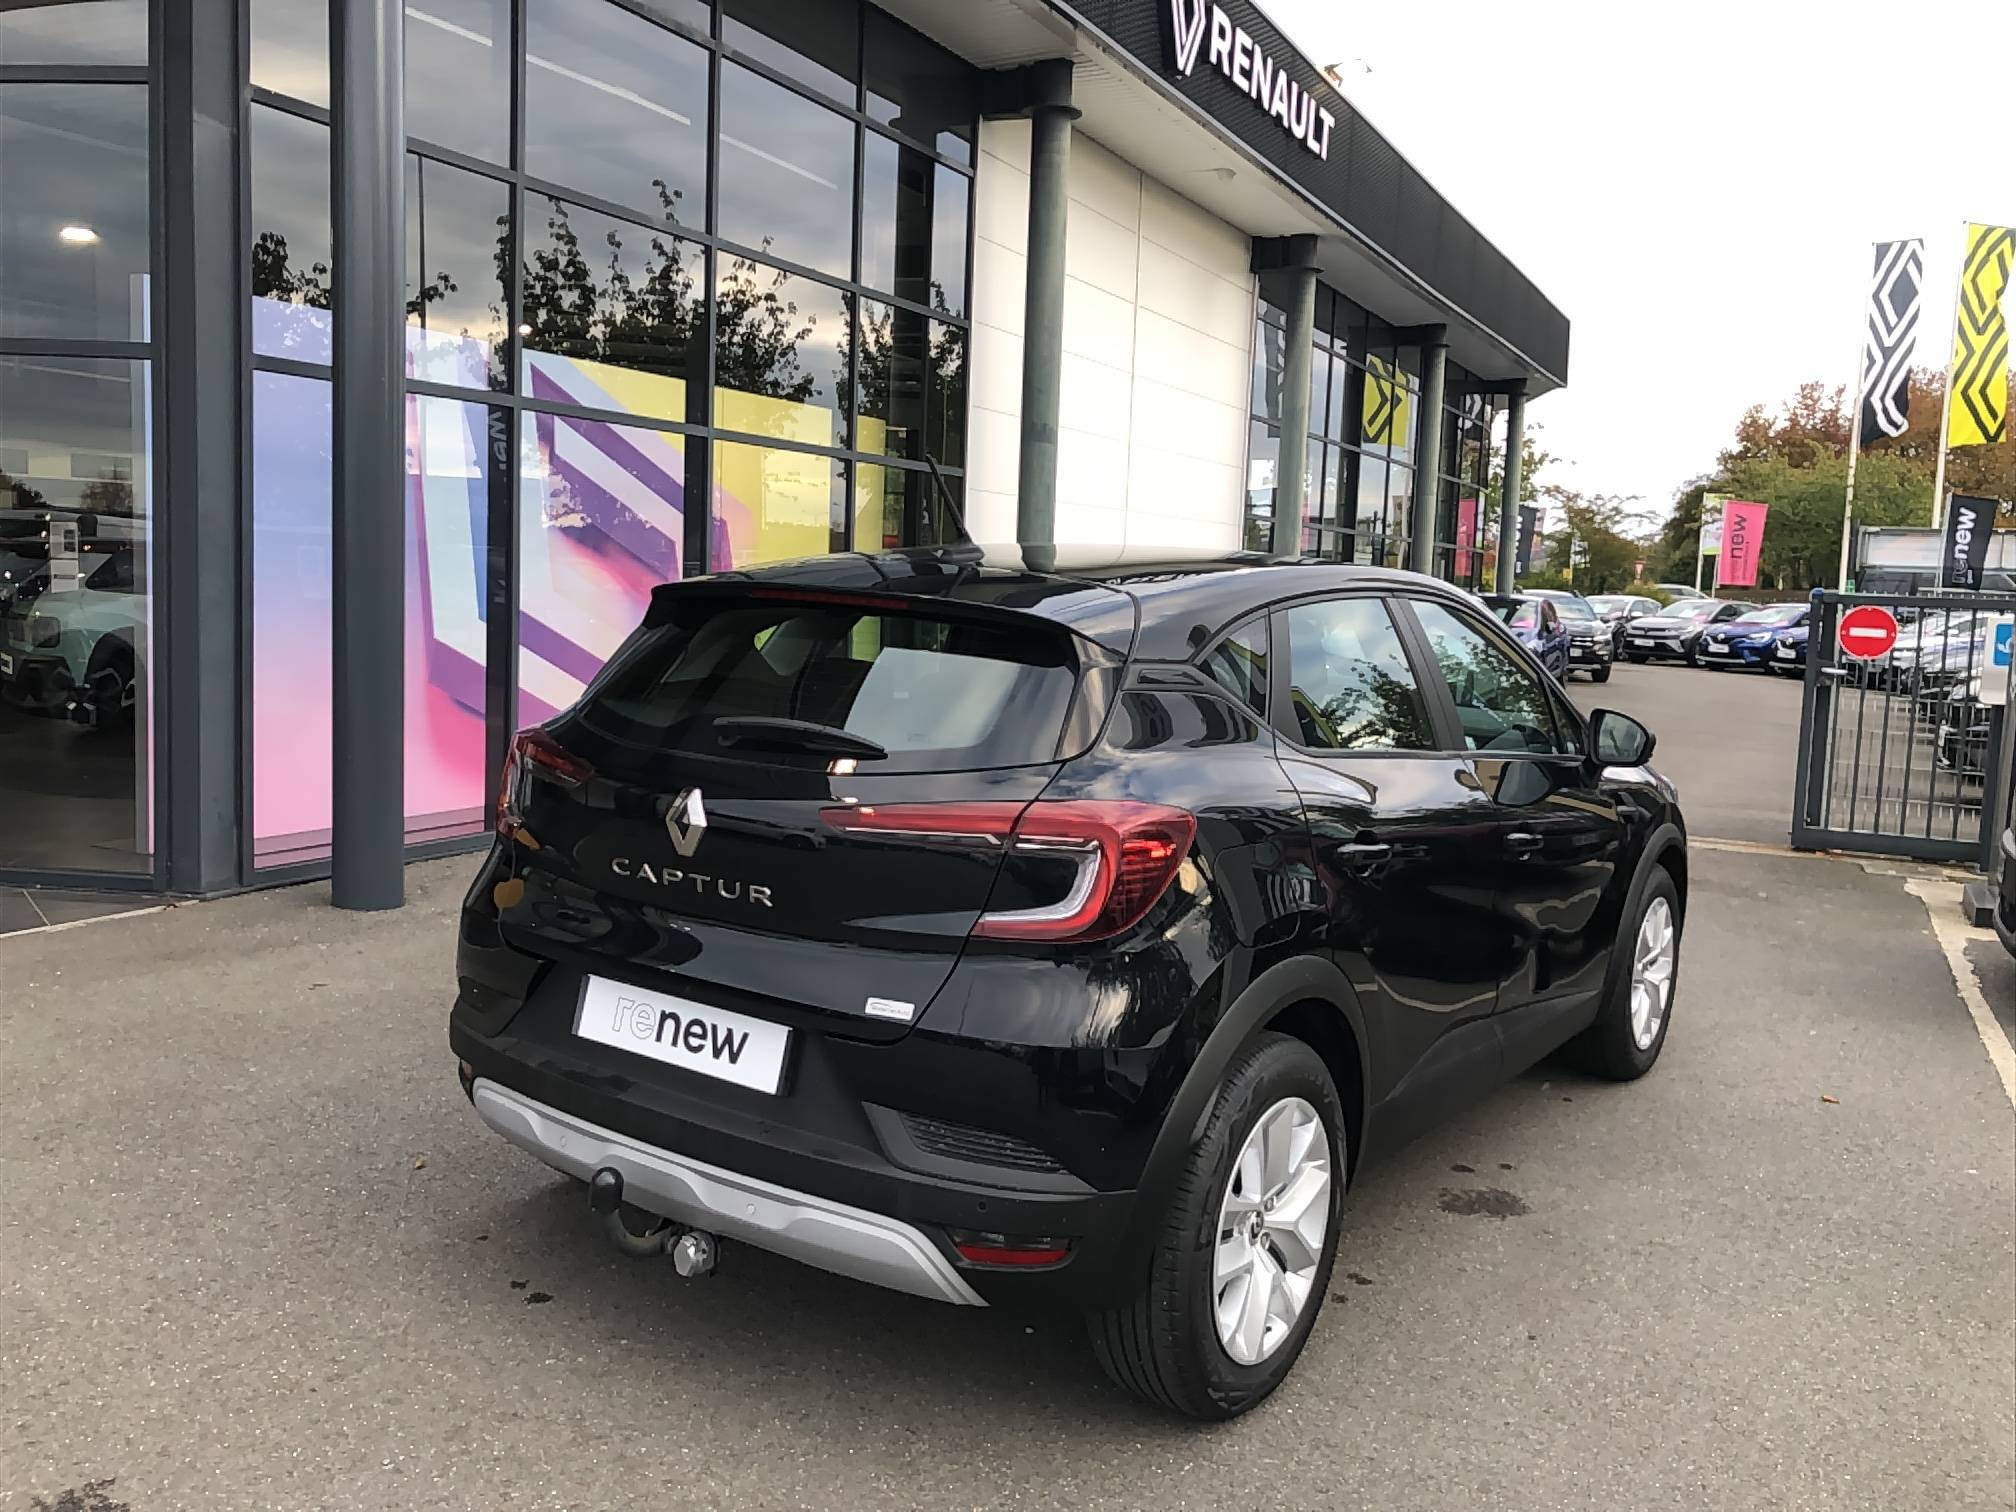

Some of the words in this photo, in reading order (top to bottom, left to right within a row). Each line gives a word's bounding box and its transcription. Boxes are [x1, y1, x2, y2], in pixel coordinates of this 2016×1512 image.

[1209, 3, 1335, 161] RENAULT
[611, 857, 774, 908] CAPTUR
[611, 996, 750, 1065] renew
